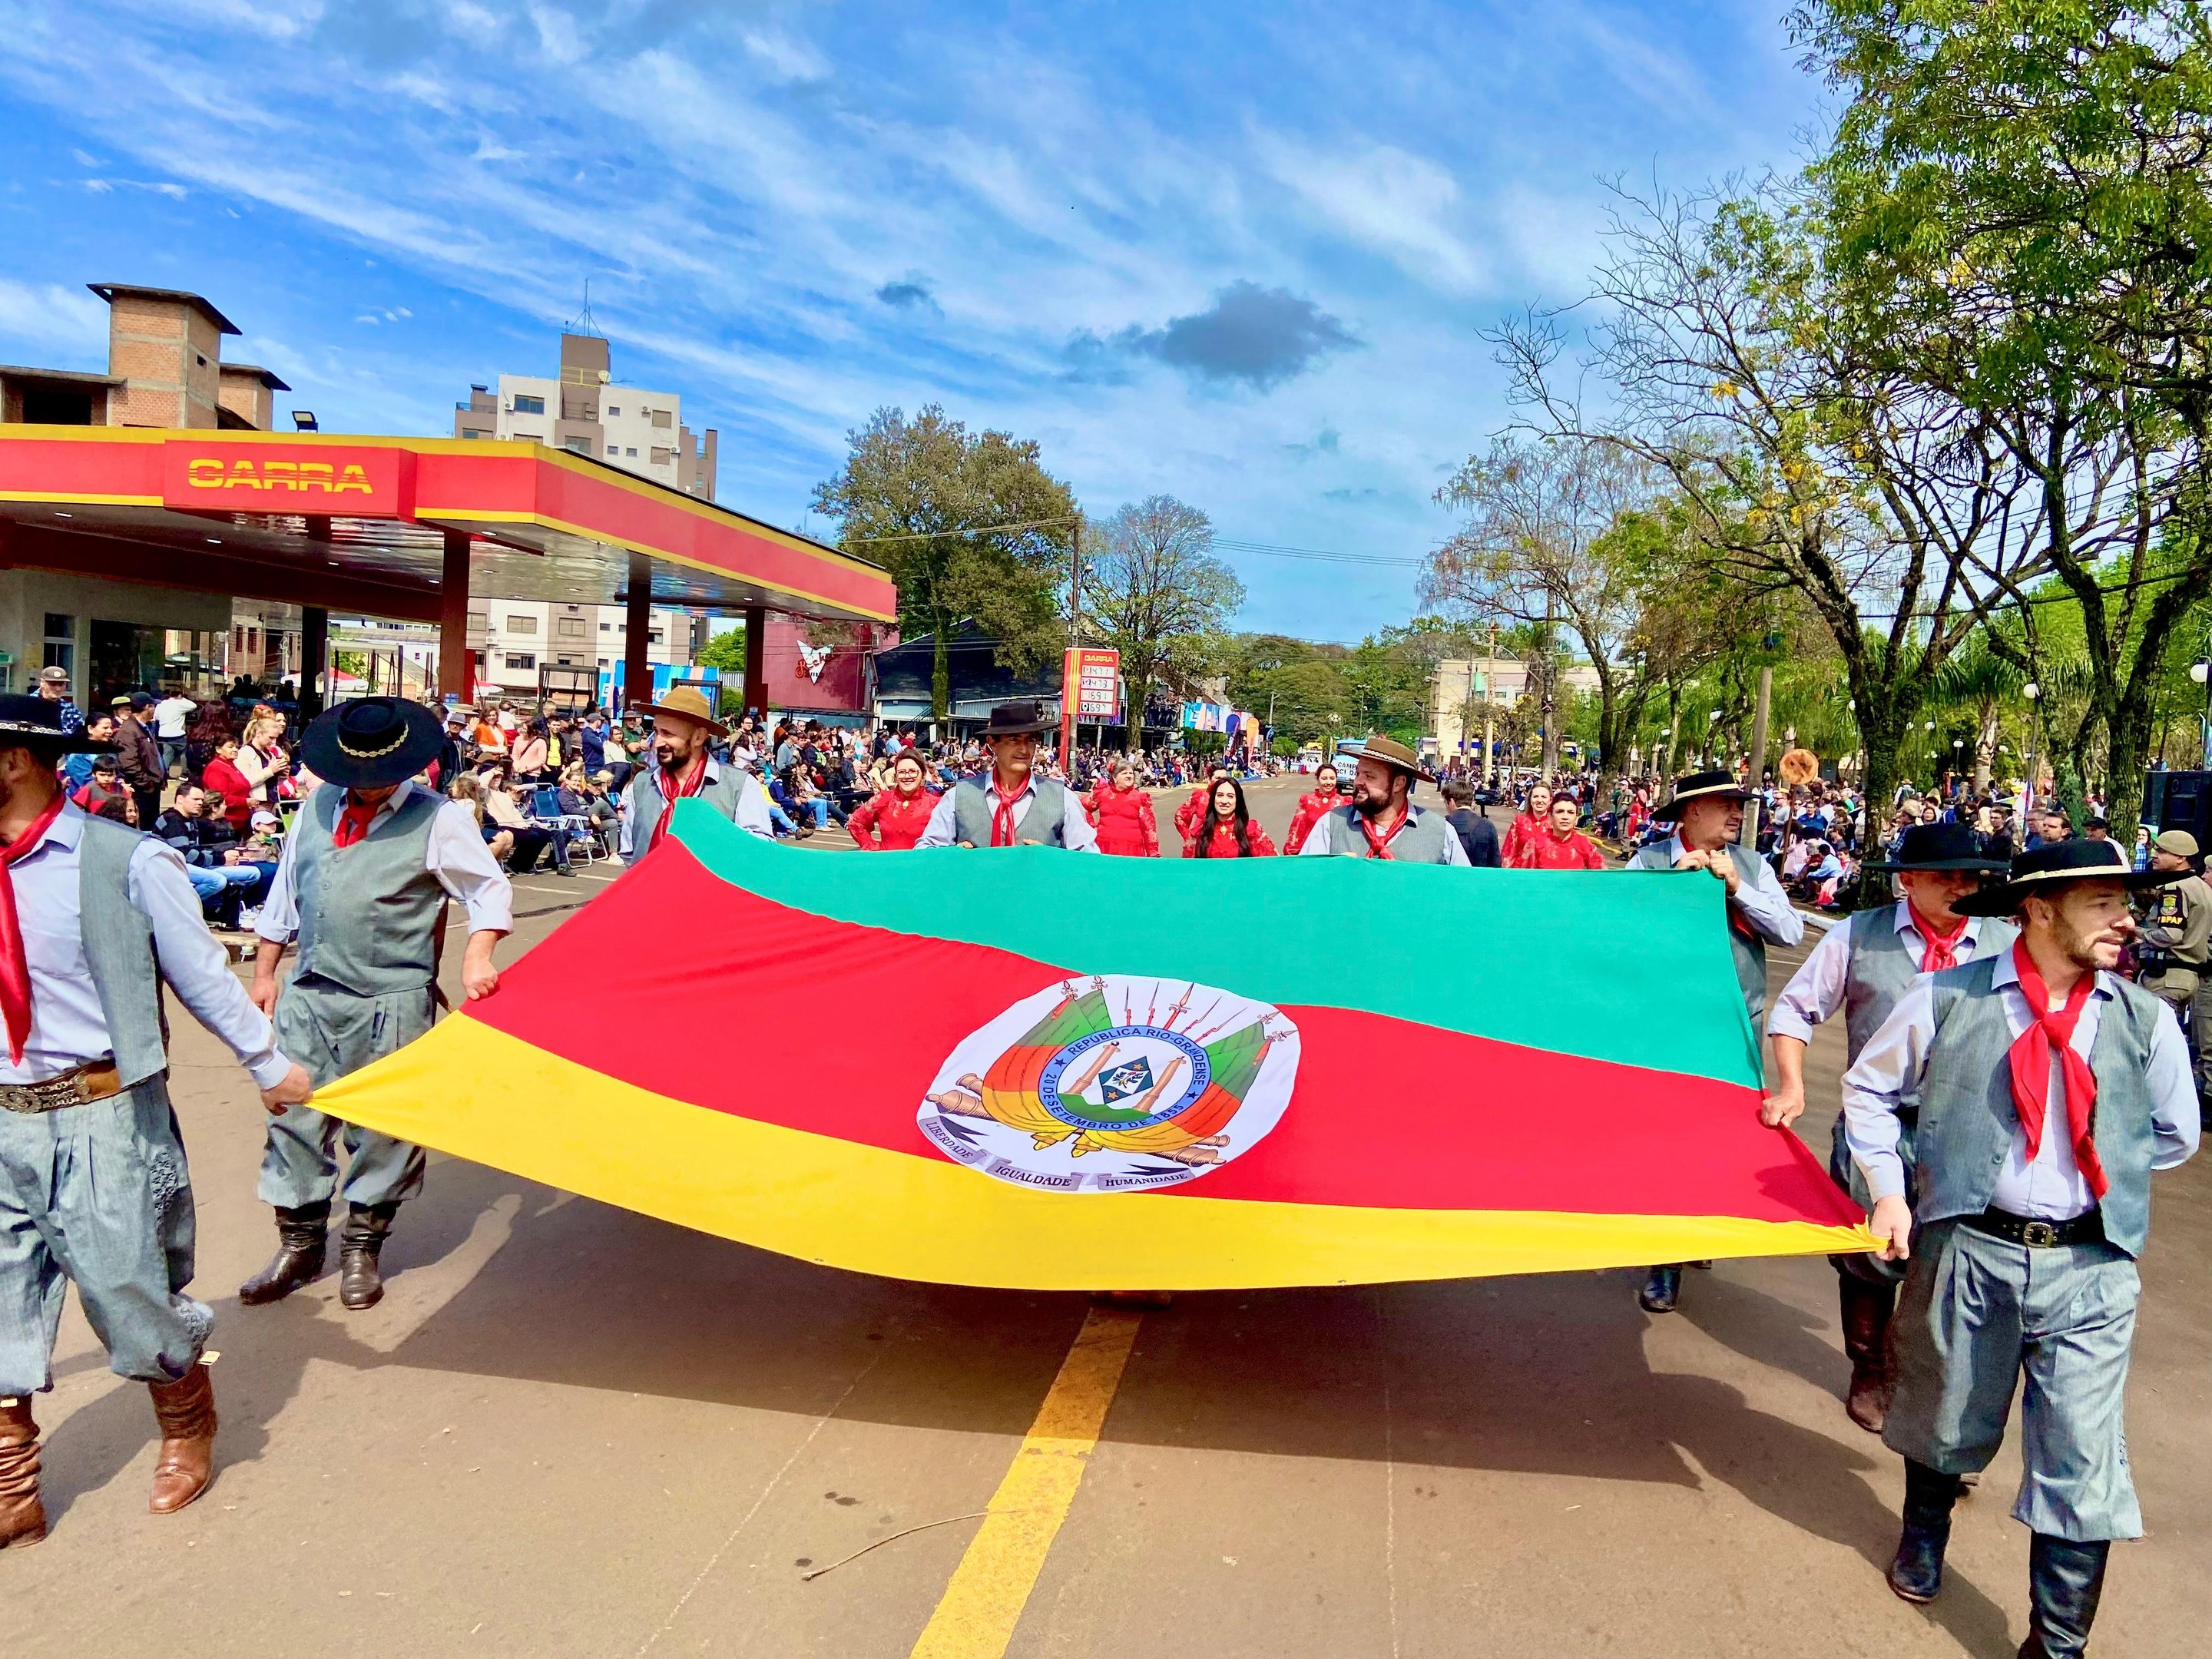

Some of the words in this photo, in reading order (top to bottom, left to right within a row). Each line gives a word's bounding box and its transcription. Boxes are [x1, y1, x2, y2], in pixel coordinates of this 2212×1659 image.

[188, 459, 374, 495] GARRA
[1068, 1028, 1142, 1056] REPÚBLICA
[1145, 1028, 1207, 1086] RIO-GRANDENSE
[1044, 1073, 1058, 1084] 20
[1128, 1119, 1149, 1129] DE
[926, 1121, 974, 1159] LIBERDADE
[995, 1165, 1073, 1187] IGUALDADE
[1105, 1173, 1188, 1187] HUMANIDADE
